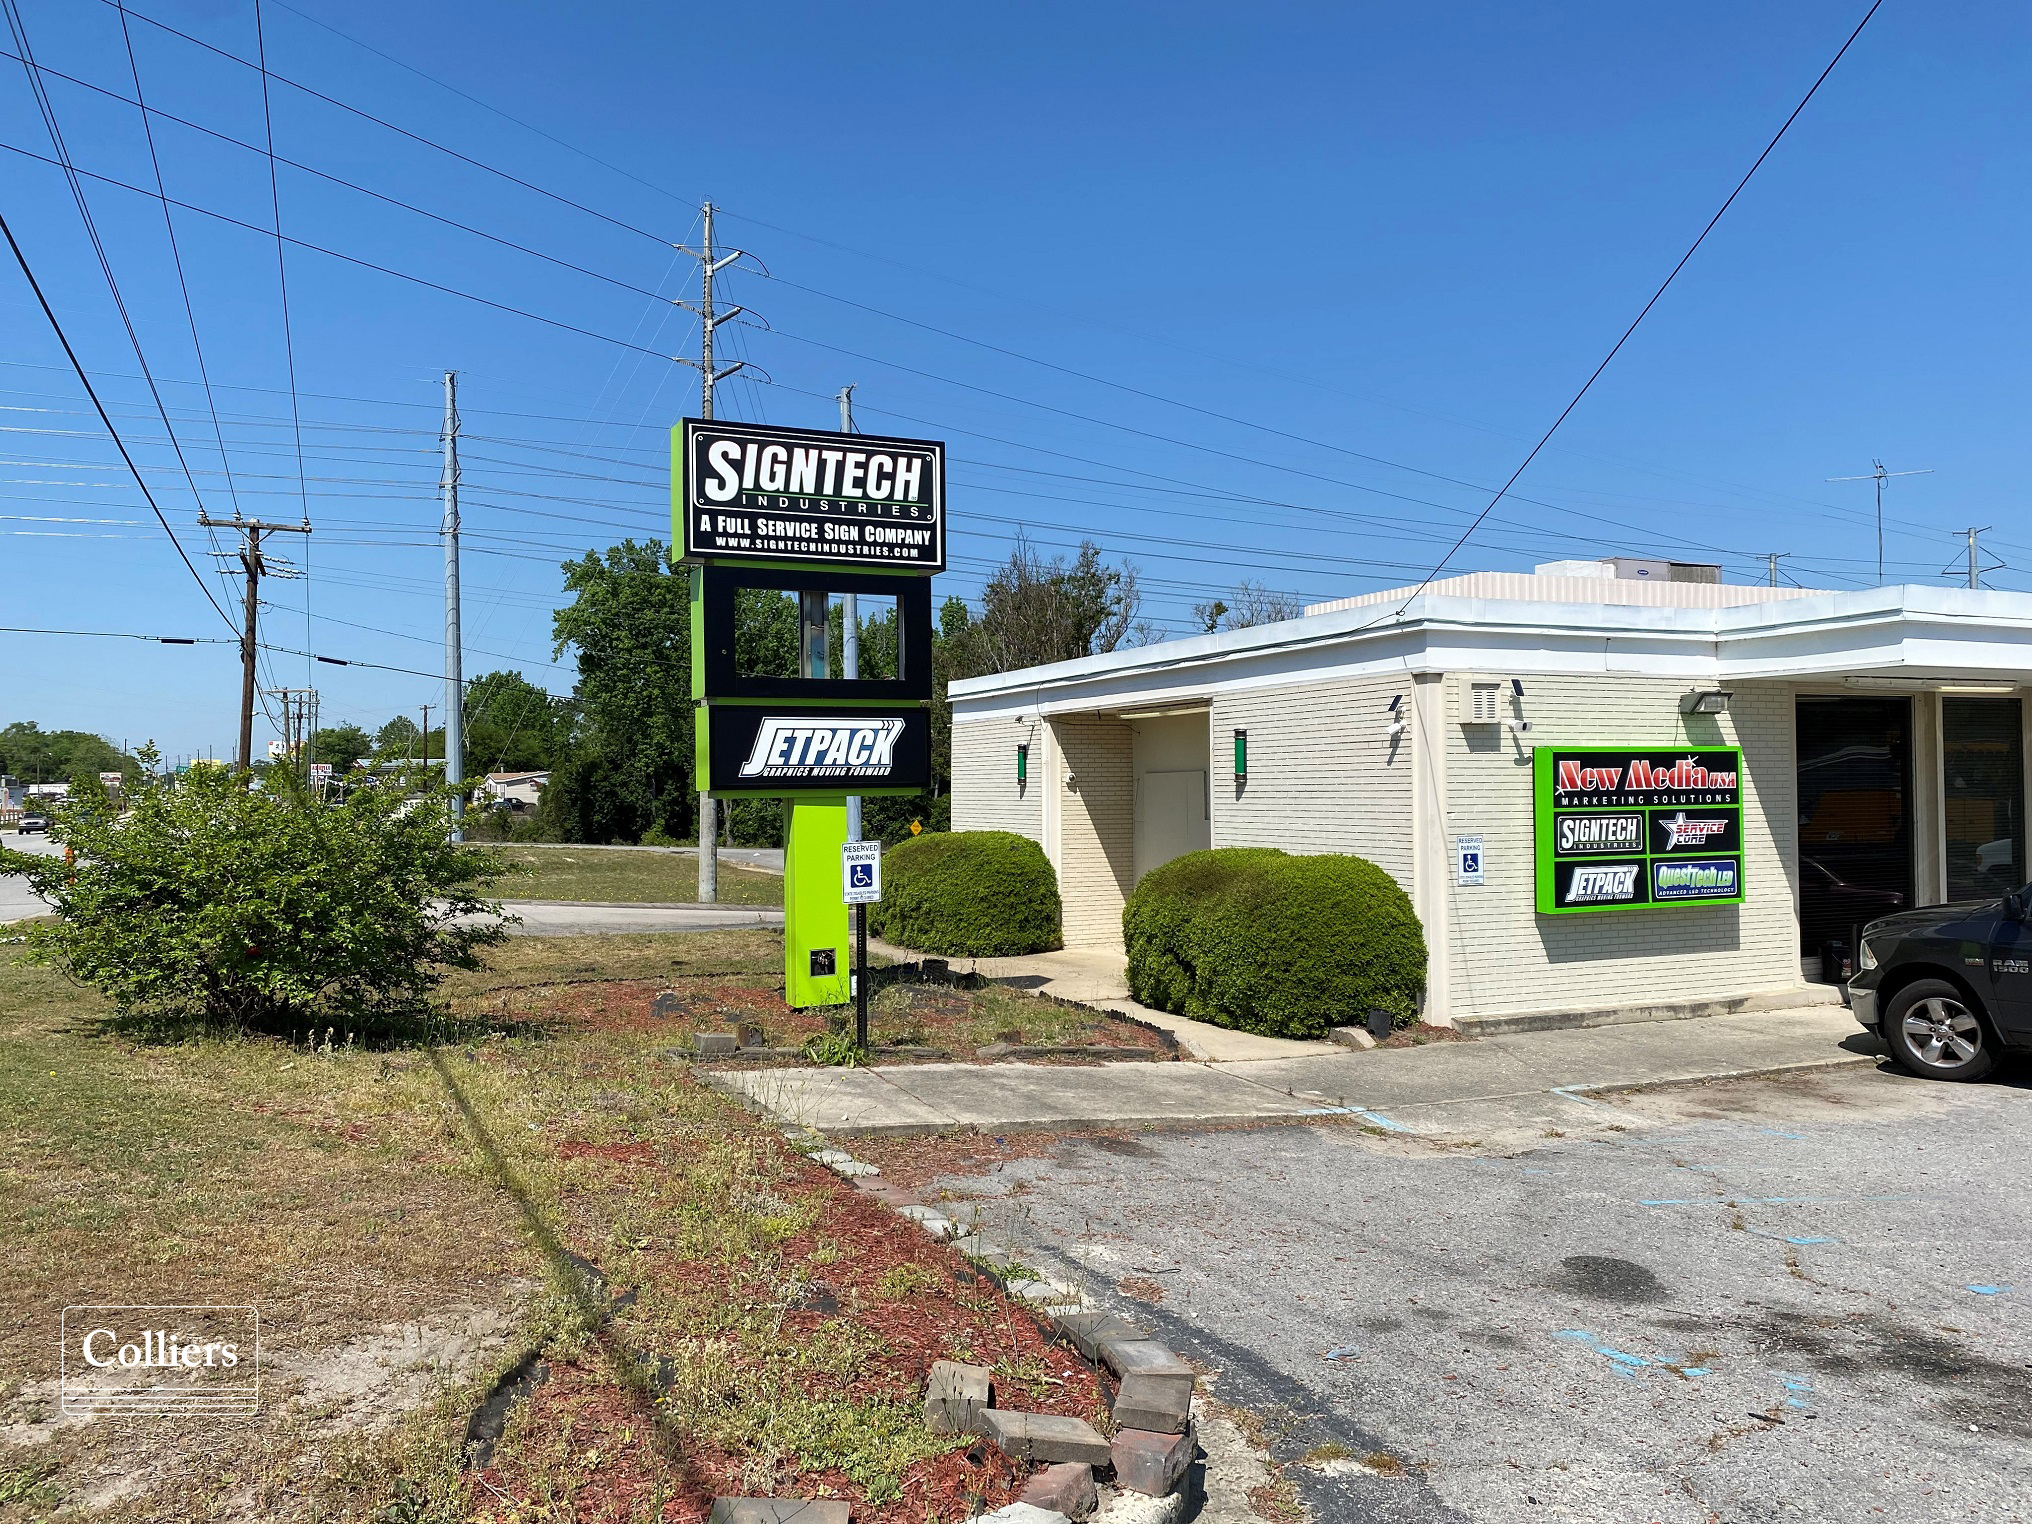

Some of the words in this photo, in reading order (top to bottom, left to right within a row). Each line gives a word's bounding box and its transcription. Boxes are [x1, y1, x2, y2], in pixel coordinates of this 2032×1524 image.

[704, 440, 922, 501] SIGNTECH
[742, 494, 919, 517] INDUSTRIES
[700, 515, 711, 532] A
[717, 515, 751, 535] FULL
[757, 519, 818, 539] SERVICE
[824, 522, 859, 541] SIGN
[865, 525, 931, 546] COMPANY
[715, 536, 919, 558] WWW.SIGNTECHINDUSTRIES.COM
[738, 716, 906, 778] JETPACK
[763, 766, 809, 777] GRAPHICS
[811, 766, 846, 777] MOVING
[848, 767, 891, 776] FORWARD
[1558, 760, 1623, 791] New
[1625, 759, 1709, 790] Media
[1709, 771, 1737, 789] USA
[1561, 795, 1644, 806] MARKETING
[1653, 794, 1731, 804] SOLUTIONS
[1562, 818, 1637, 849] SIGNTECH
[1676, 823, 1724, 834] SERVICE
[843, 844, 879, 853] RESERVED
[1573, 841, 1637, 850] INDUSTRIES
[846, 853, 876, 862] PARKING
[1564, 864, 1640, 902] JETPACK
[1992, 959, 2029, 967] RAM
[1993, 966, 2029, 974] 1500
